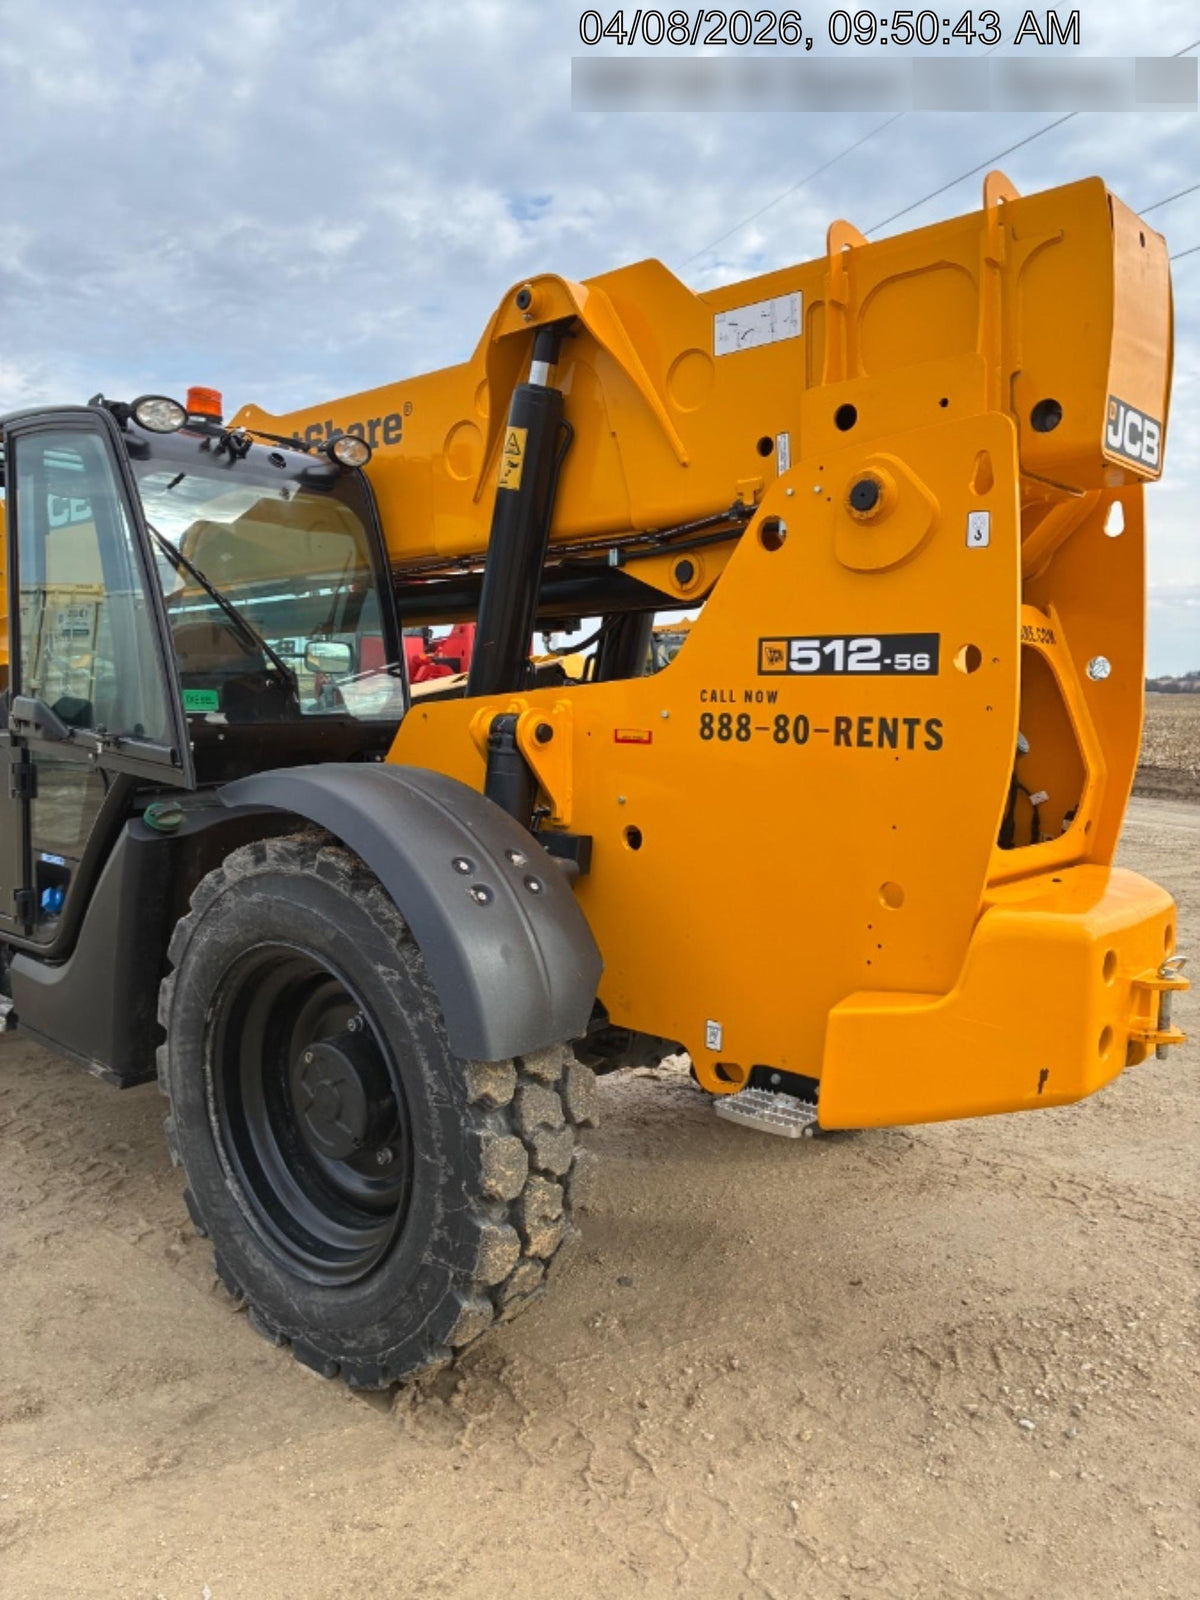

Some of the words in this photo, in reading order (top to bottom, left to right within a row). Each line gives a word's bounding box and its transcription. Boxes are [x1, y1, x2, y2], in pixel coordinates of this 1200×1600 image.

[1107, 405, 1160, 465] JCB
[789, 637, 931, 673] 512-56
[700, 688, 737, 704] CALL
[744, 689, 779, 705] NOW
[699, 711, 944, 751] 888-80-RENTS
